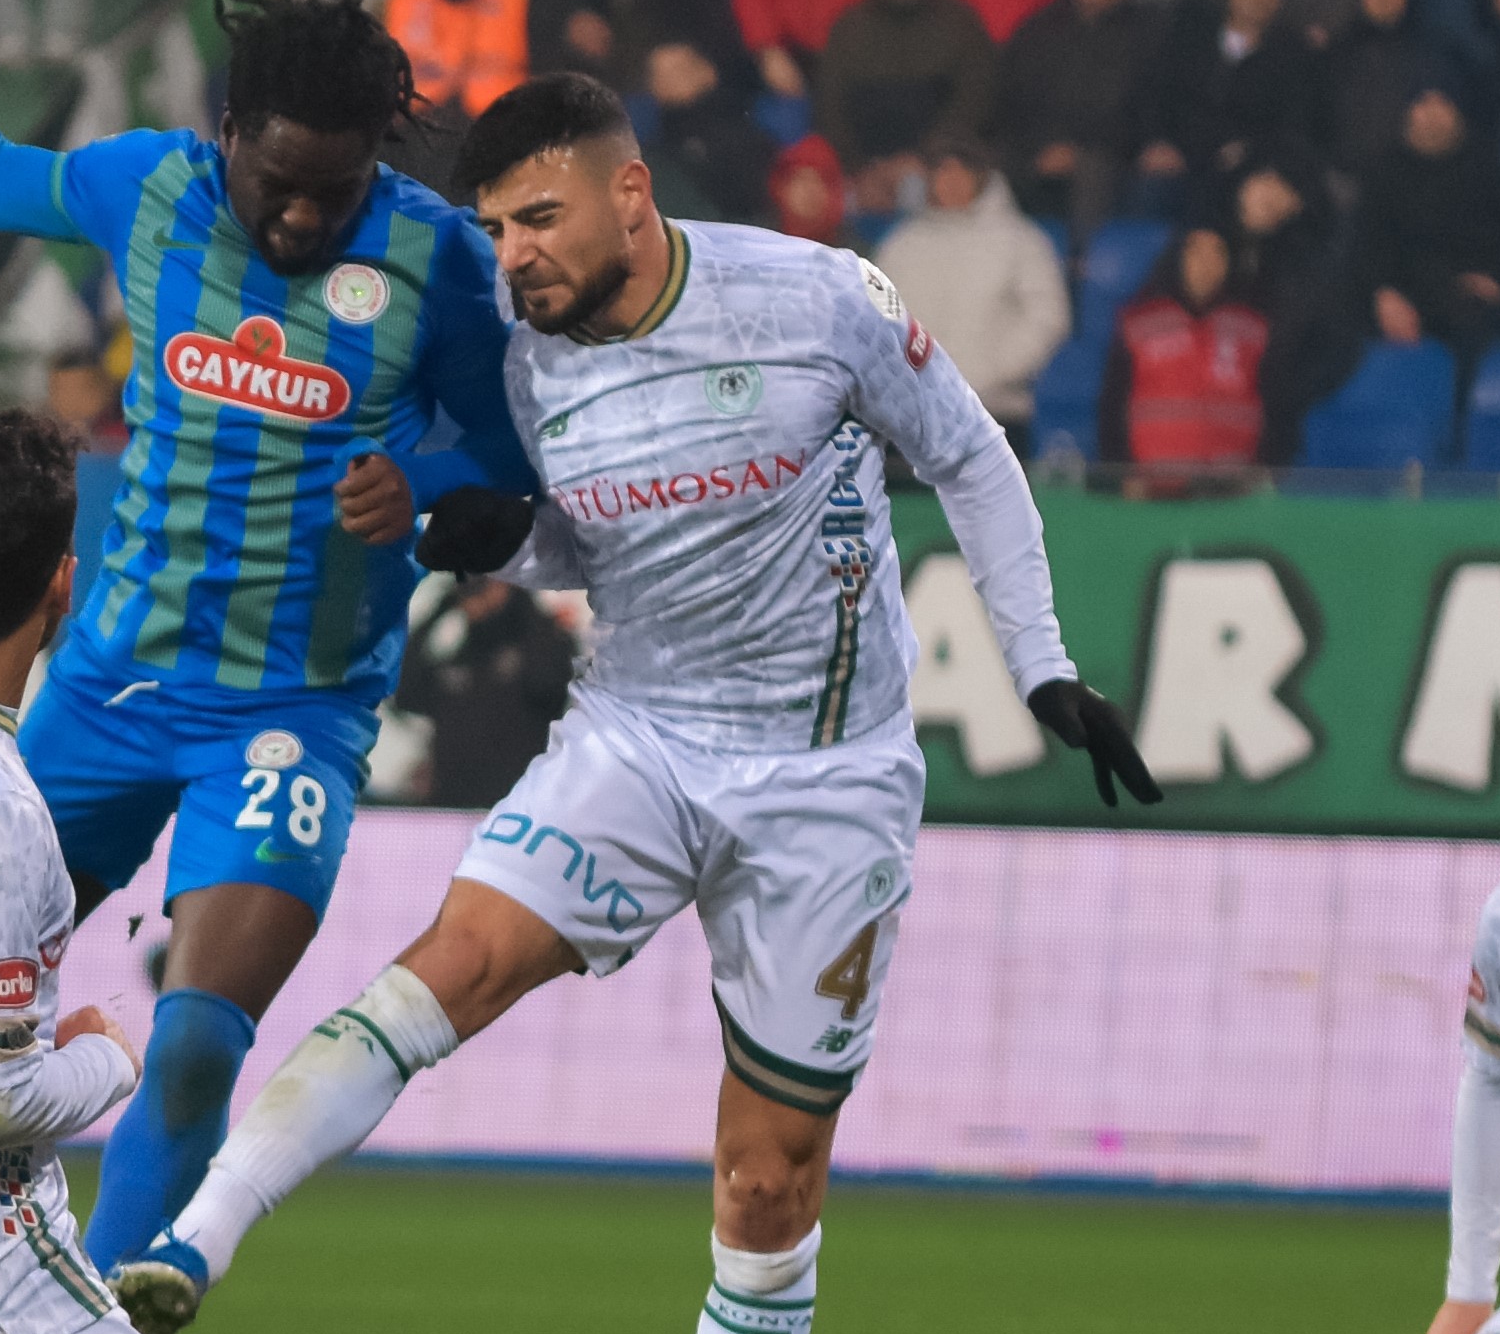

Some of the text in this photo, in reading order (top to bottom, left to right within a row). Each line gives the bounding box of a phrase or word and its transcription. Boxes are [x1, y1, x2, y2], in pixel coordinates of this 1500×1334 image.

[177, 344, 332, 411] ÇAYKUR
[570, 447, 808, 523] TÜMOSAN
[234, 768, 327, 846] 28
[814, 920, 880, 1021] 4
